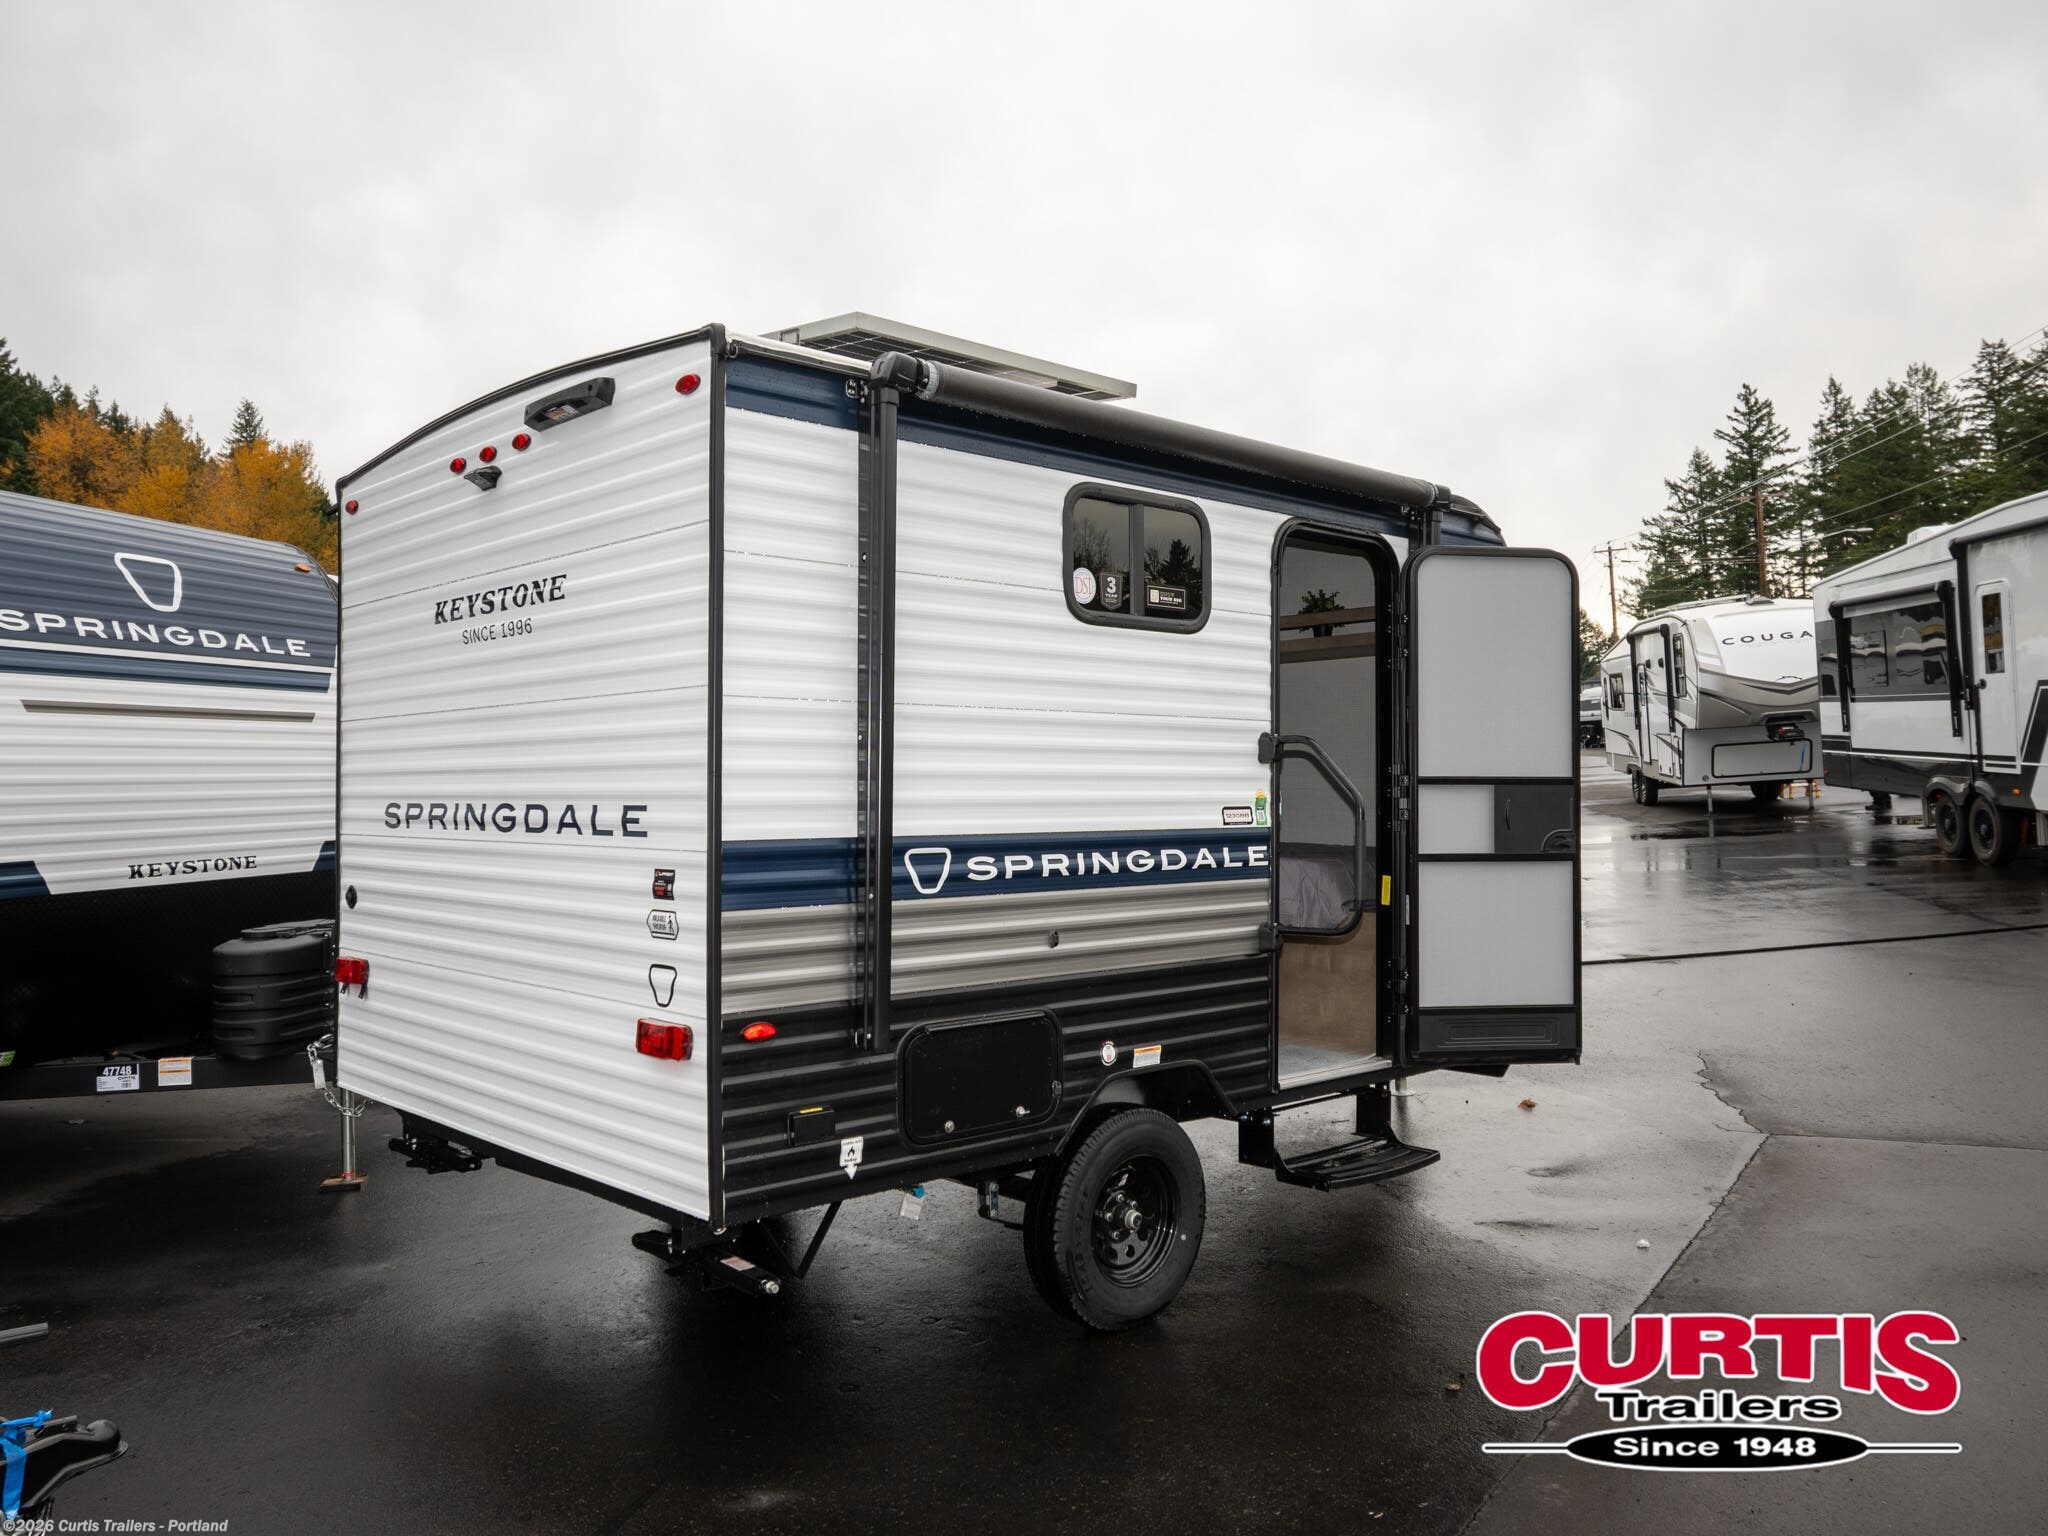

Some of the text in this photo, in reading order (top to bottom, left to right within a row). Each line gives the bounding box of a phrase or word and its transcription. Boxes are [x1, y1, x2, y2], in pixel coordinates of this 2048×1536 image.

[434, 574, 567, 624] KEYSTONE
[1106, 576, 1116, 594] 3
[0, 608, 310, 657] SPRINGDALE
[462, 617, 533, 645] SINCE 1996
[1722, 630, 1813, 645] COUGA
[385, 802, 648, 838] SPRINGDALE
[128, 855, 257, 879] KEYSTONE
[966, 845, 1269, 881] SPRINGDALE
[103, 1066, 132, 1076] 47748
